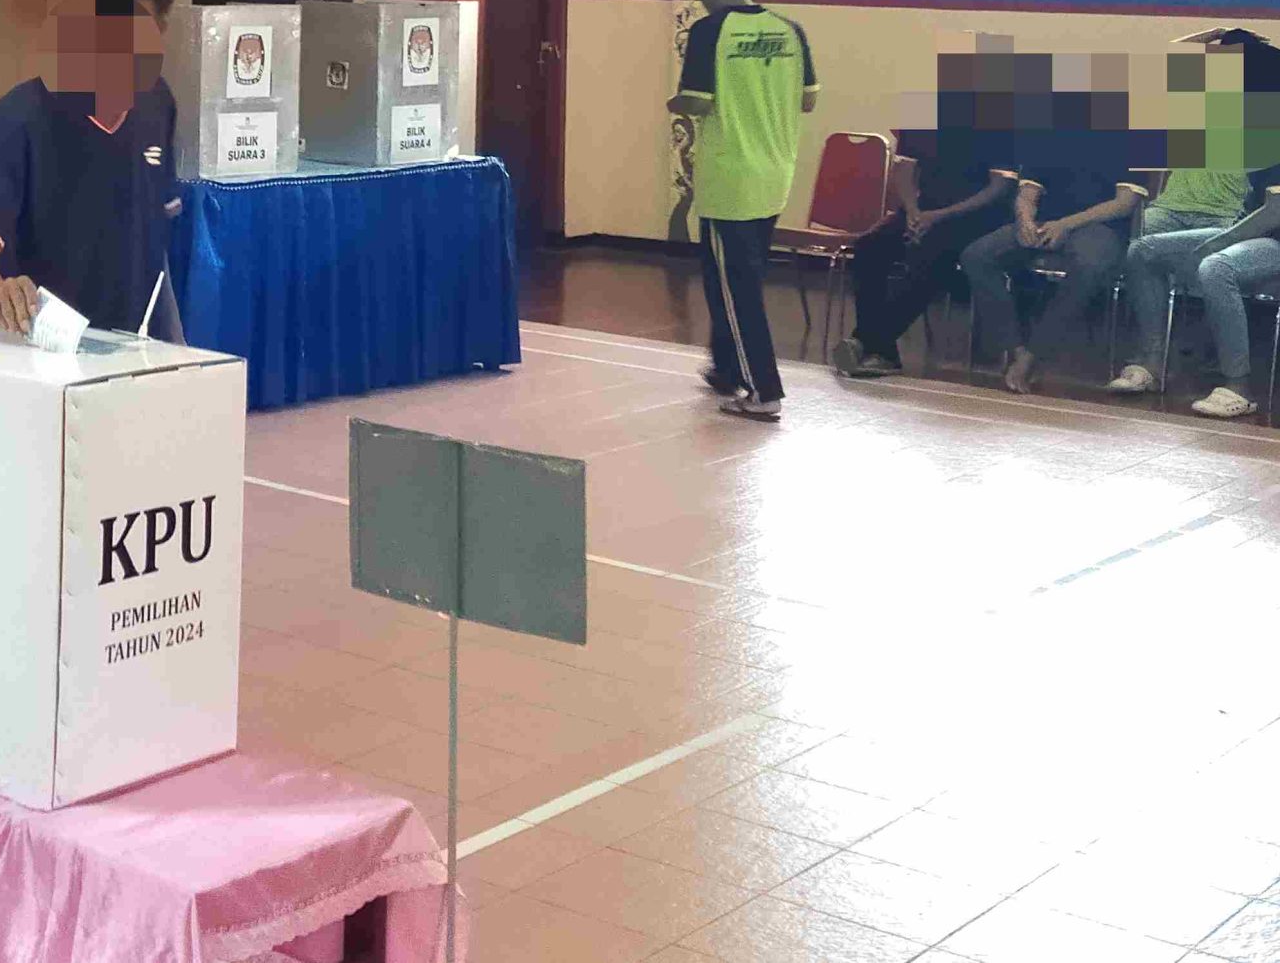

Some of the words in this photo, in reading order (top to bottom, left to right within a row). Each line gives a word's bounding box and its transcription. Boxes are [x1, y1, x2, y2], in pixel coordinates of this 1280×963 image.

[407, 126, 426, 137] BILIK
[236, 136, 258, 146] BILIK
[400, 139, 425, 151] SUARA
[426, 138, 432, 148] 4
[228, 150, 258, 162] SUARA
[260, 149, 266, 160] 3
[98, 495, 216, 586] KPU
[111, 590, 202, 632] PEMILIHAN
[105, 631, 162, 664] TAHUN
[165, 620, 205, 648] 2024
